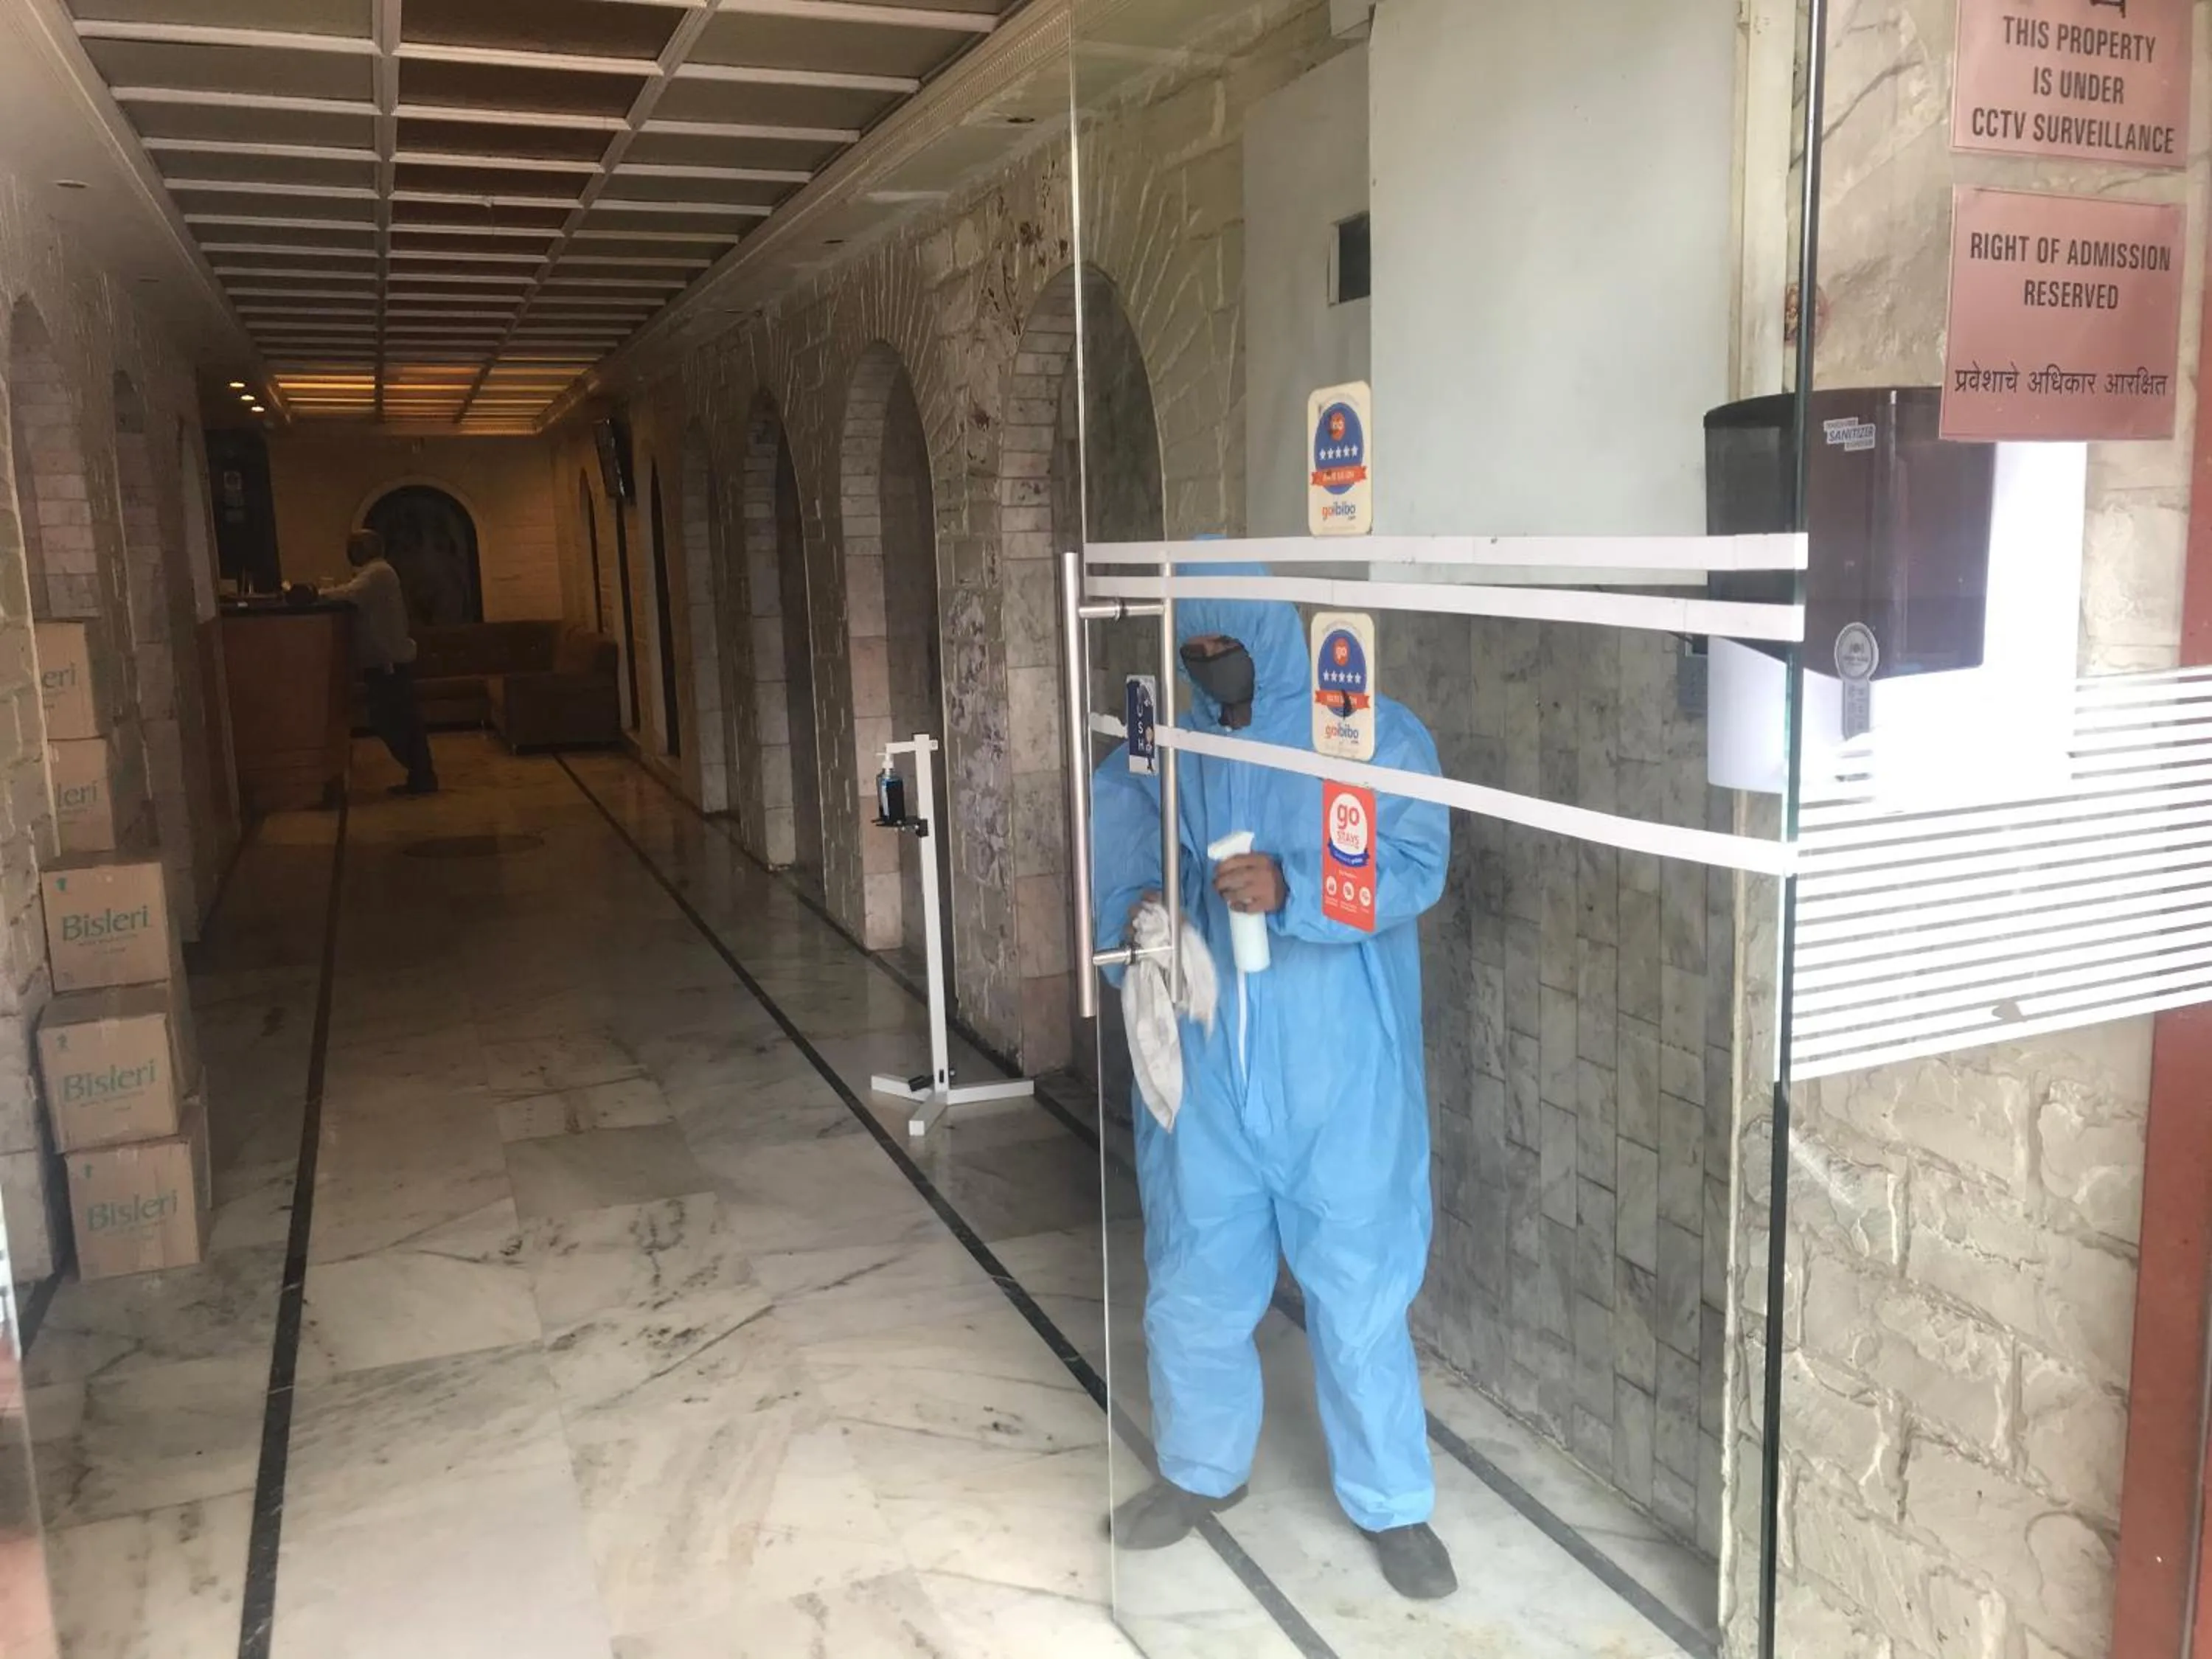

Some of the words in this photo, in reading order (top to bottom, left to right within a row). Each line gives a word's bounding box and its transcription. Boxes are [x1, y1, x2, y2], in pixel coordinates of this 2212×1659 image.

[2003, 15, 2049, 49] THIS
[2056, 24, 2155, 63] PROPERTY
[2033, 66, 2052, 96] IS
[2060, 71, 2124, 104] UNDER
[1972, 108, 2026, 139] CCTV
[2033, 114, 2174, 154] SURVEILLANCE
[1970, 232, 2030, 262] RIGHT
[2037, 237, 2060, 263] OF
[2067, 240, 2171, 271] ADMISSION
[2024, 279, 2119, 310] RESERVED
[1954, 361, 2020, 394] प्रवेशाचे
[2028, 364, 2096, 394] अधिकार
[2104, 366, 2168, 396] आरक्षित
[1829, 425, 1874, 441] SANITIZER
[1321, 501, 1356, 521] goibibo
[1325, 722, 1359, 740] goibibo
[1337, 803, 1360, 830] go
[1336, 830, 1360, 849] STAYS
[62, 905, 148, 941] Bisleri
[63, 1058, 156, 1102] Bisleri
[87, 1189, 178, 1232] Bisleri
